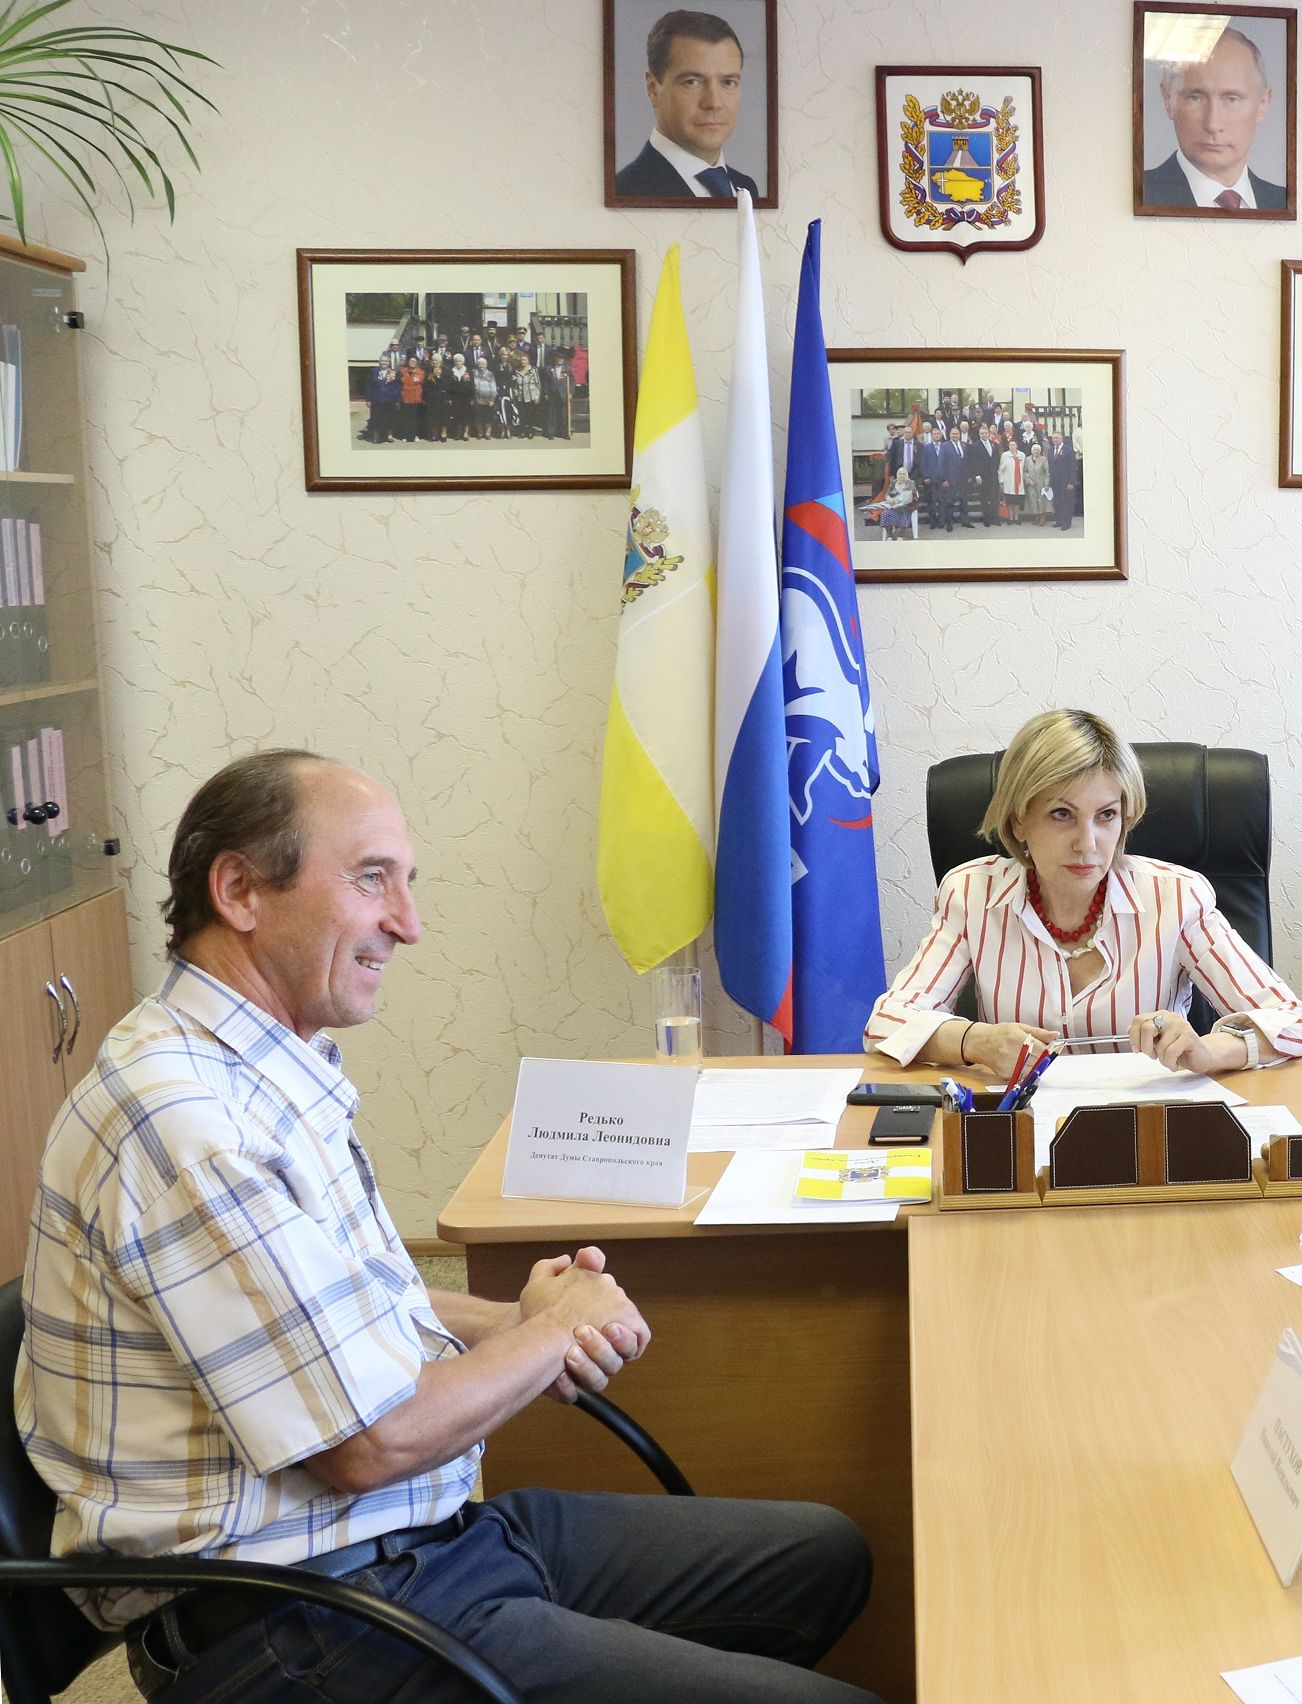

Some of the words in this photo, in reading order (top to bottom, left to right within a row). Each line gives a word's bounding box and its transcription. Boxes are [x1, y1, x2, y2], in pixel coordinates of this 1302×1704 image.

[579, 1112, 624, 1125] Редько
[528, 1127, 589, 1141] Людмила
[592, 1131, 671, 1146] Леонидовна
[529, 1152, 558, 1161] Депутат
[560, 1153, 581, 1162] Думы
[582, 1154, 644, 1165] Ставропольского
